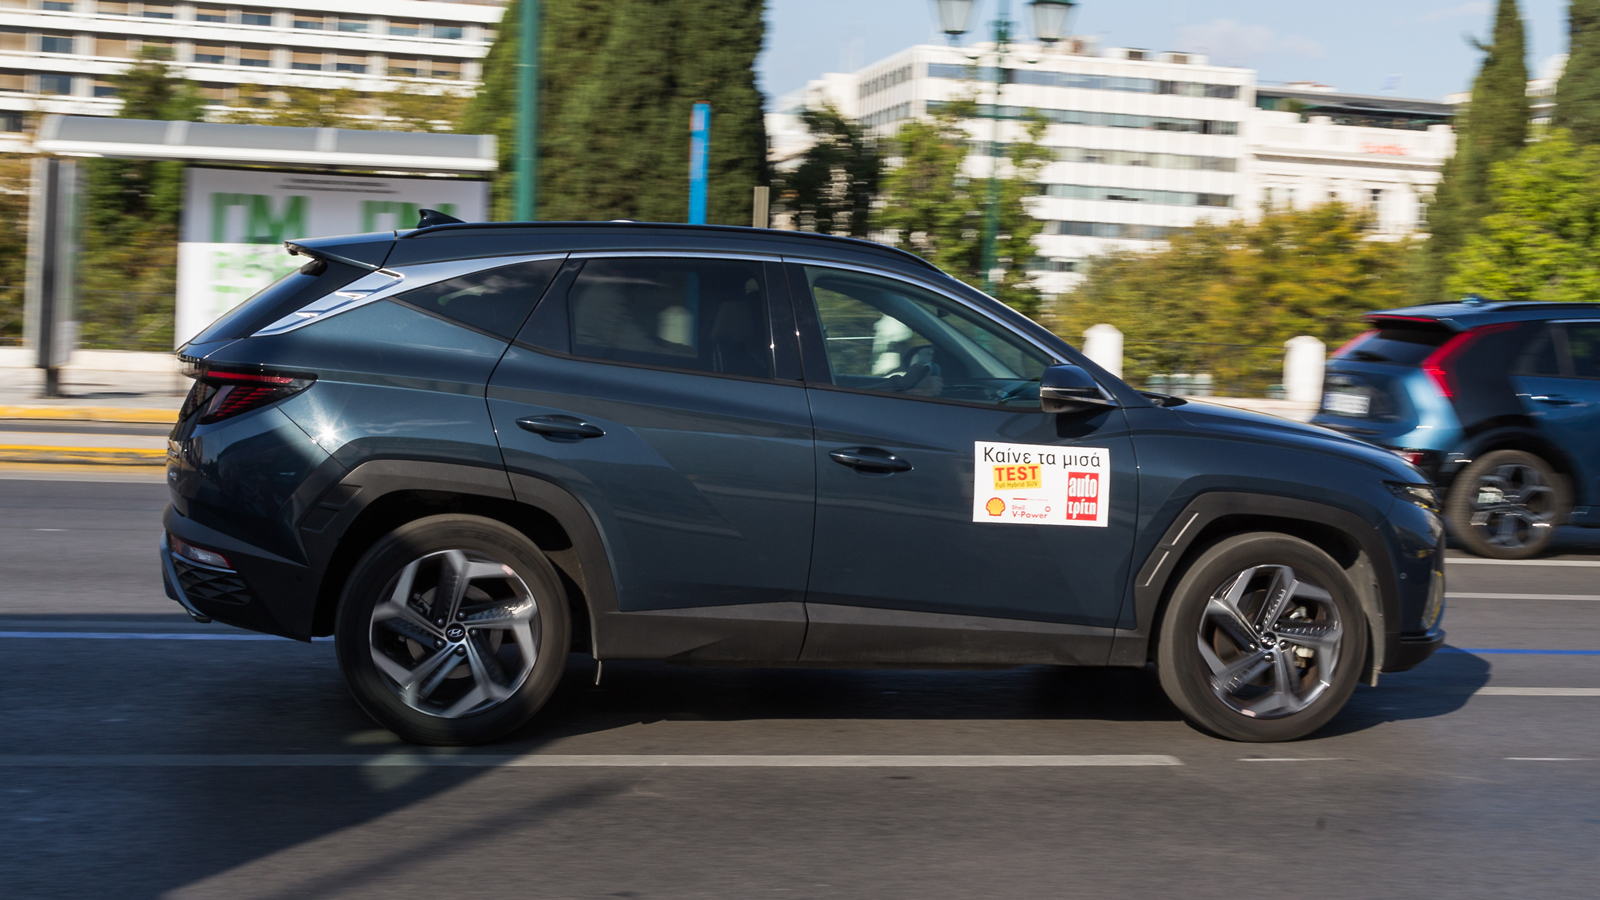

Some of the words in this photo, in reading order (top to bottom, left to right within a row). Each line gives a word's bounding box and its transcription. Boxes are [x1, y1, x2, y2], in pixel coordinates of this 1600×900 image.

[984, 447, 1031, 464] Καίνε
[1038, 453, 1056, 465] τα
[1063, 452, 1101, 469] μισά
[994, 466, 1039, 481] TEST
[1006, 481, 1025, 489] Hybrid
[1068, 474, 1098, 498] auto
[1011, 511, 1048, 519] V-Power
